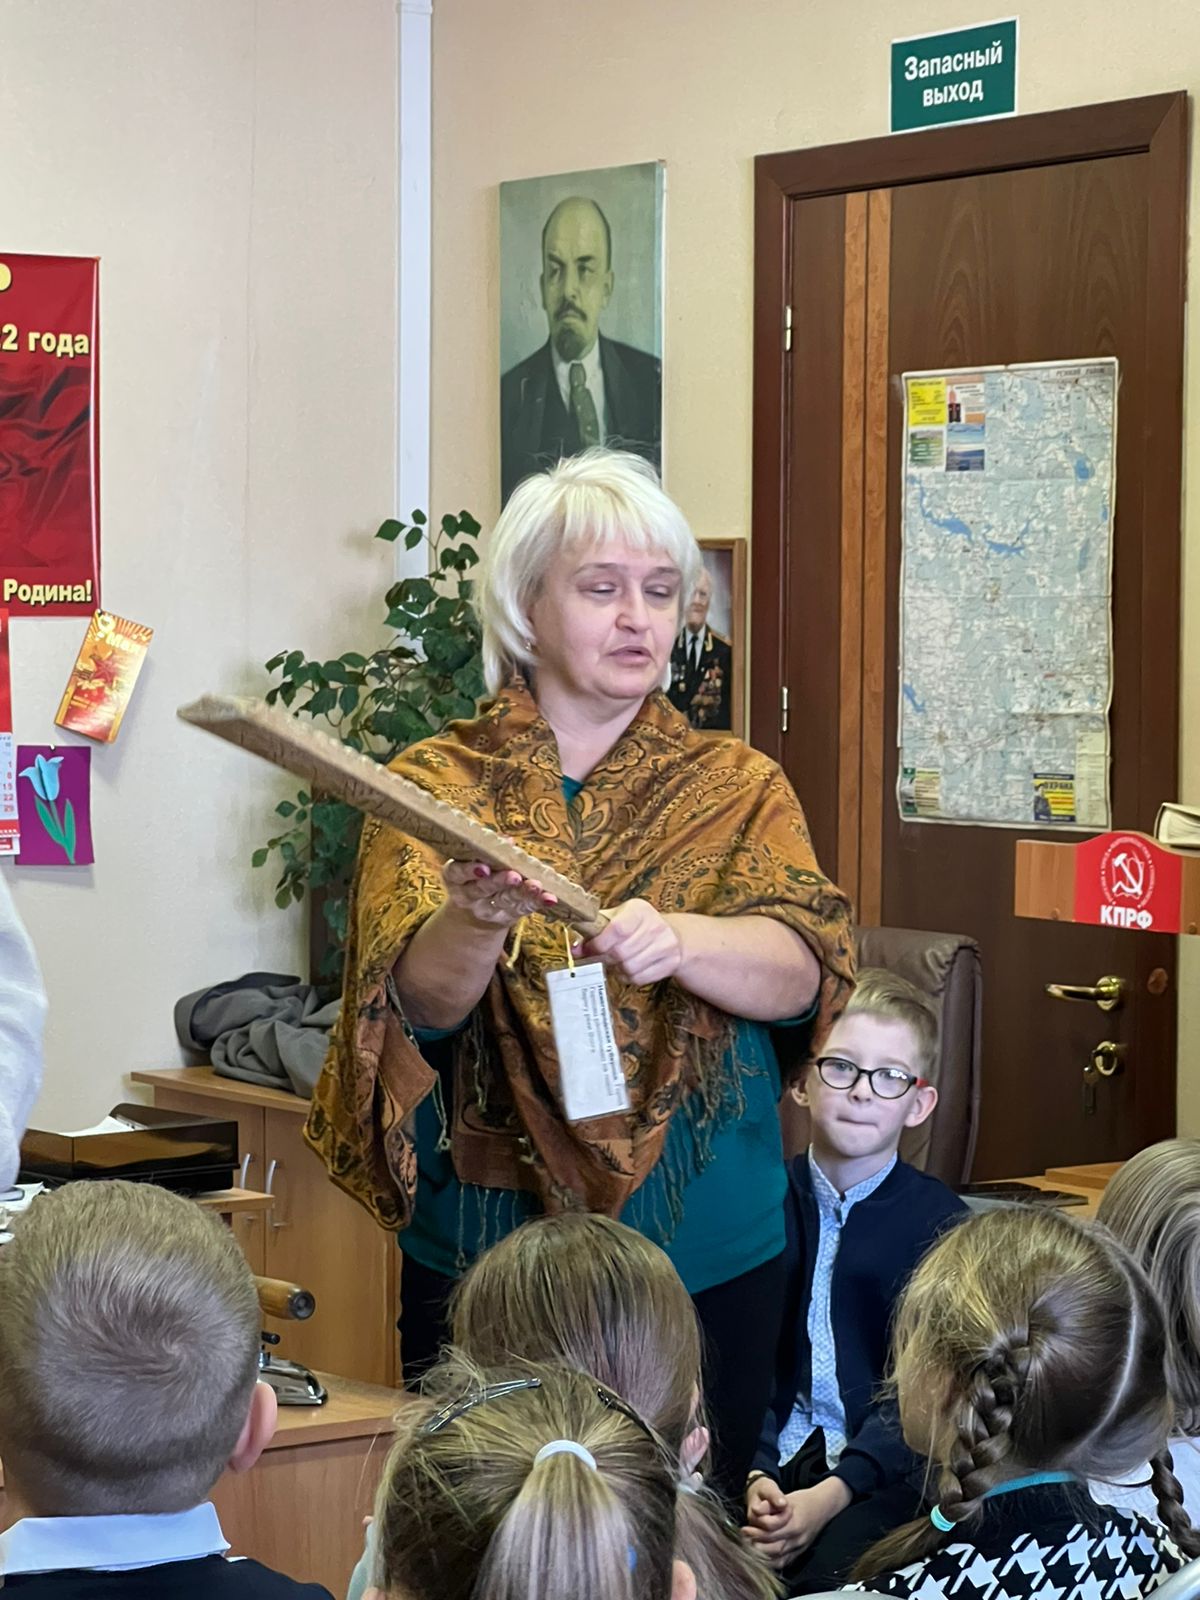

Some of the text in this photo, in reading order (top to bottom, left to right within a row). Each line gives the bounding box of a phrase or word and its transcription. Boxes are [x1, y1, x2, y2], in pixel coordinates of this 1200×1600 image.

[904, 39, 1003, 81] Запасный
[922, 79, 984, 107] выход
[0, 323, 89, 358] 2 года
[3, 578, 92, 606] Родина!
[1100, 905, 1153, 929] КПРФ
